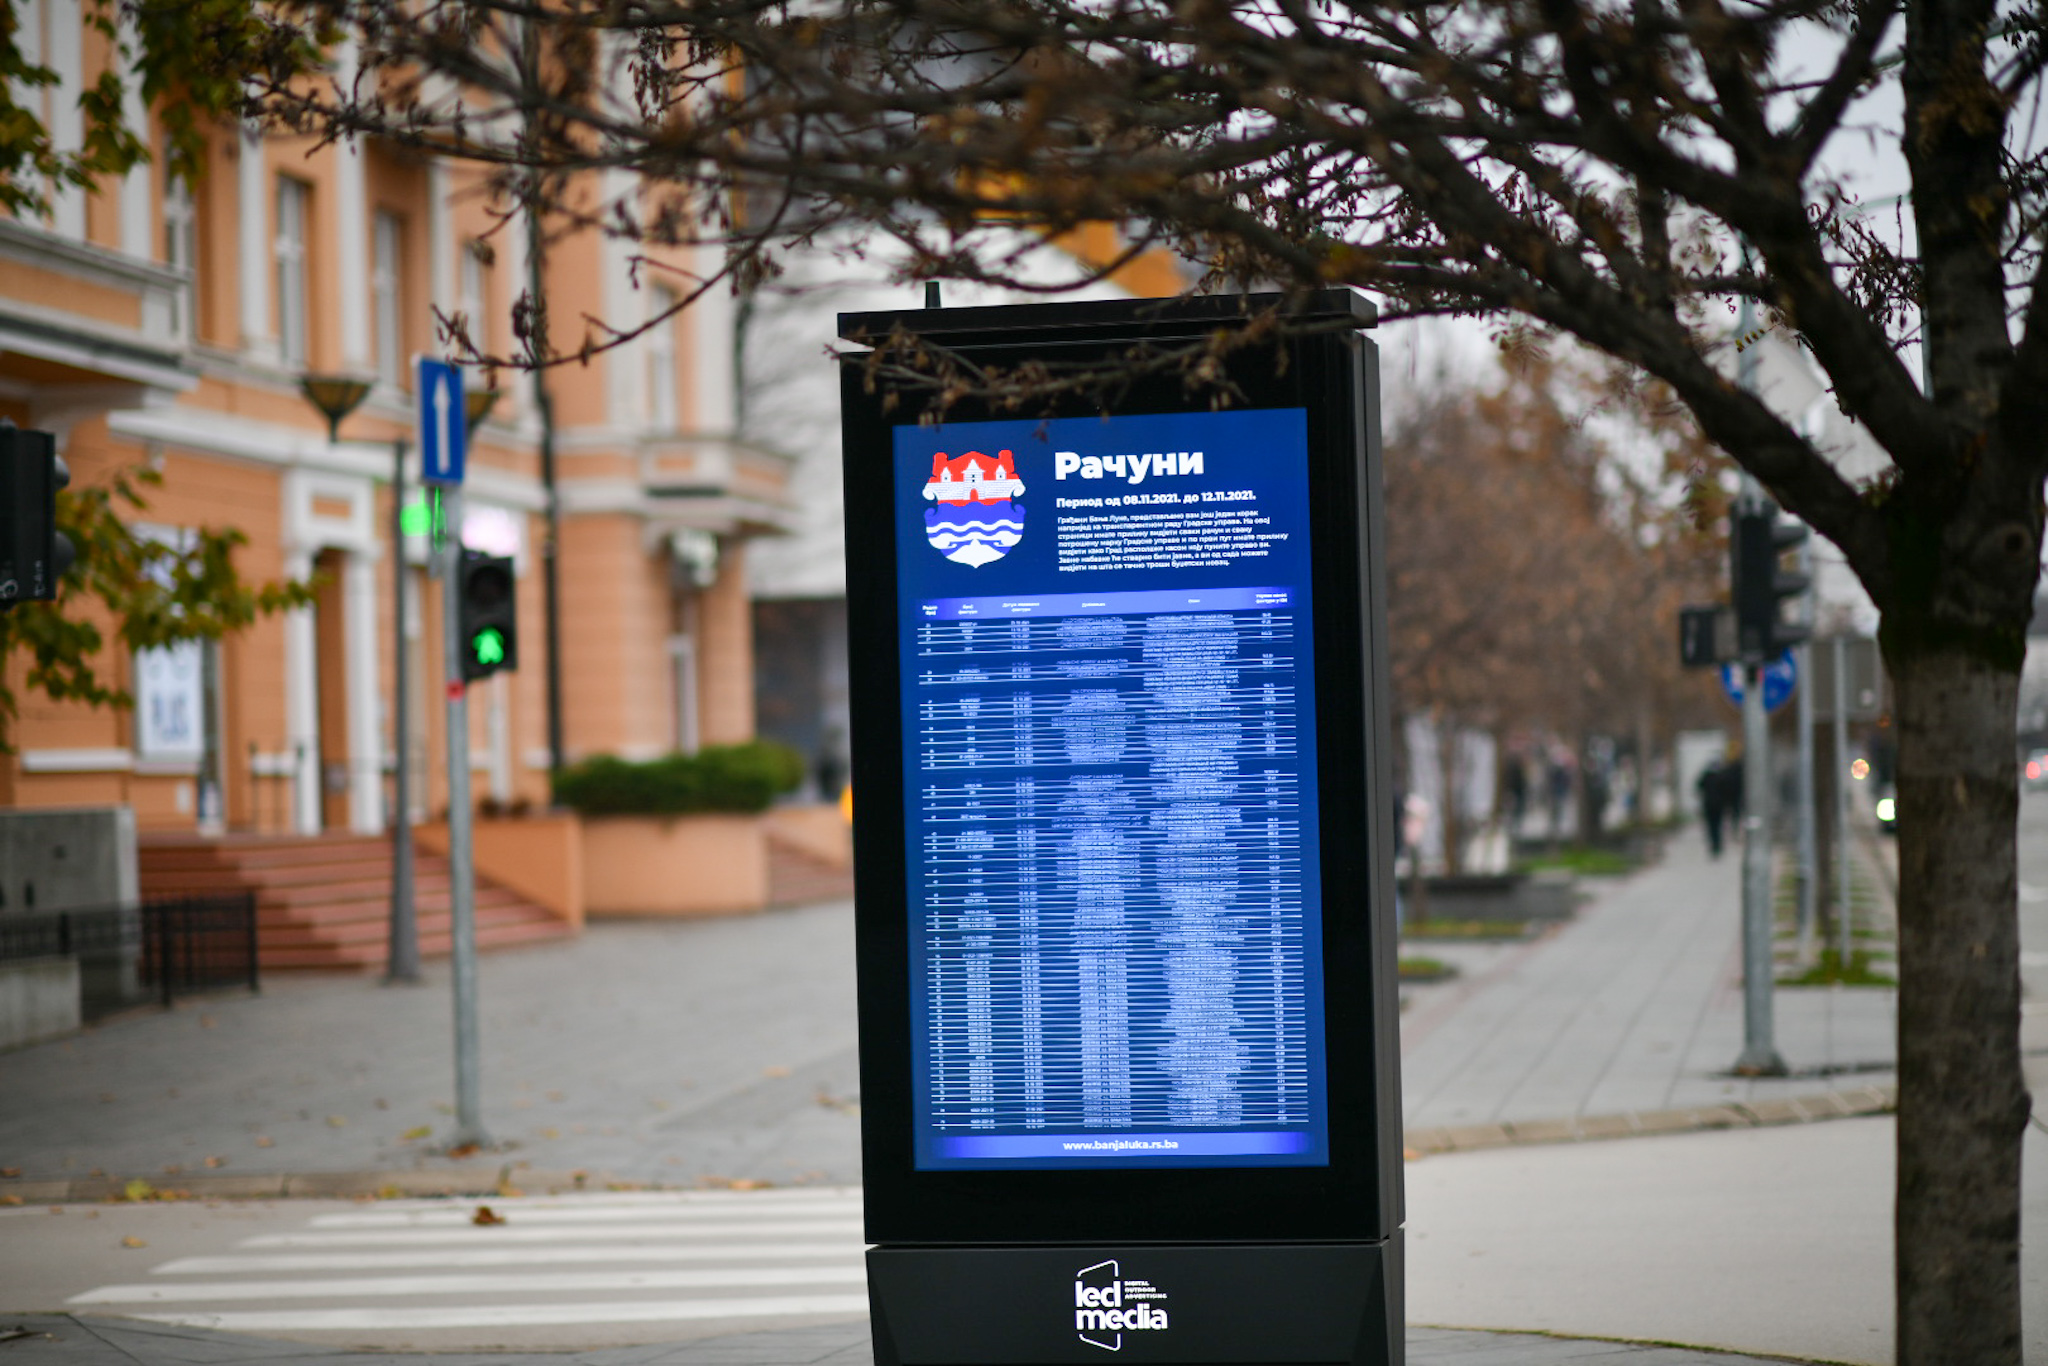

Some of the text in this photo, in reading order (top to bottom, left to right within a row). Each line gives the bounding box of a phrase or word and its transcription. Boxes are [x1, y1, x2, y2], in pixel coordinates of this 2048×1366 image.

[1055, 451, 1204, 485] Рачуни
[1056, 490, 1256, 509] Период од 08.11.2021. до 12.11.2021.
[1062, 1140, 1179, 1152] www.banjaluka.rs.ba
[1075, 1280, 1121, 1308] led
[1075, 1302, 1168, 1330] media
